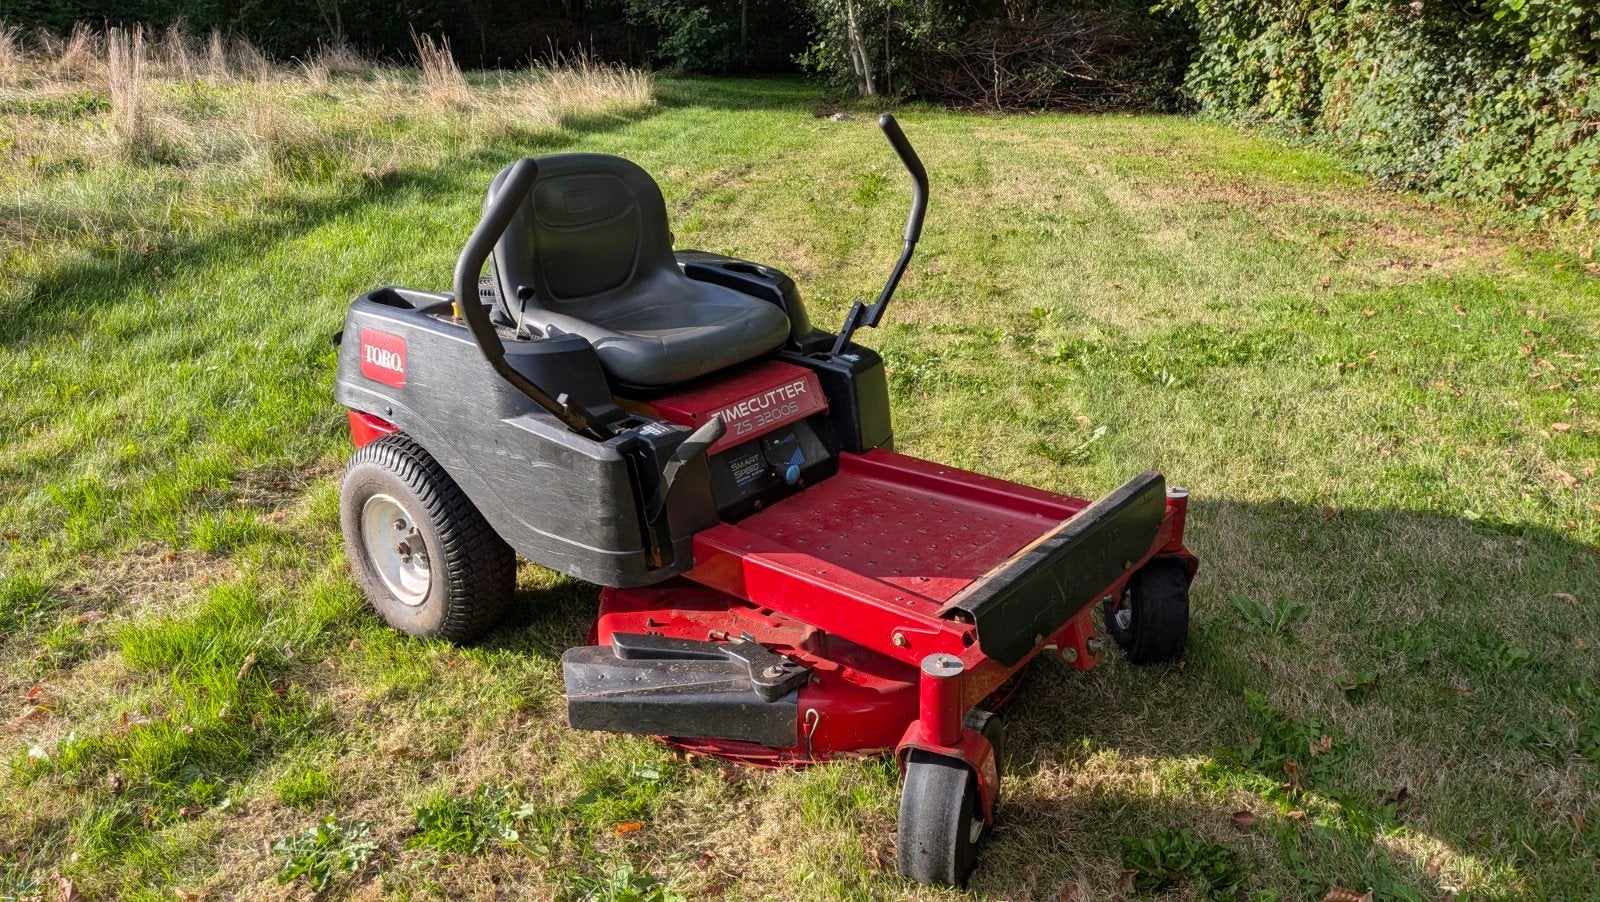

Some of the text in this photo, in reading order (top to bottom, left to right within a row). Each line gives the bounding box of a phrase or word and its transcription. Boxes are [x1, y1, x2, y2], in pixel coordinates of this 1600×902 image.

[734, 401, 799, 435] ZS 3200S
[731, 454, 759, 472] SMART
[734, 463, 759, 480] SPEED
